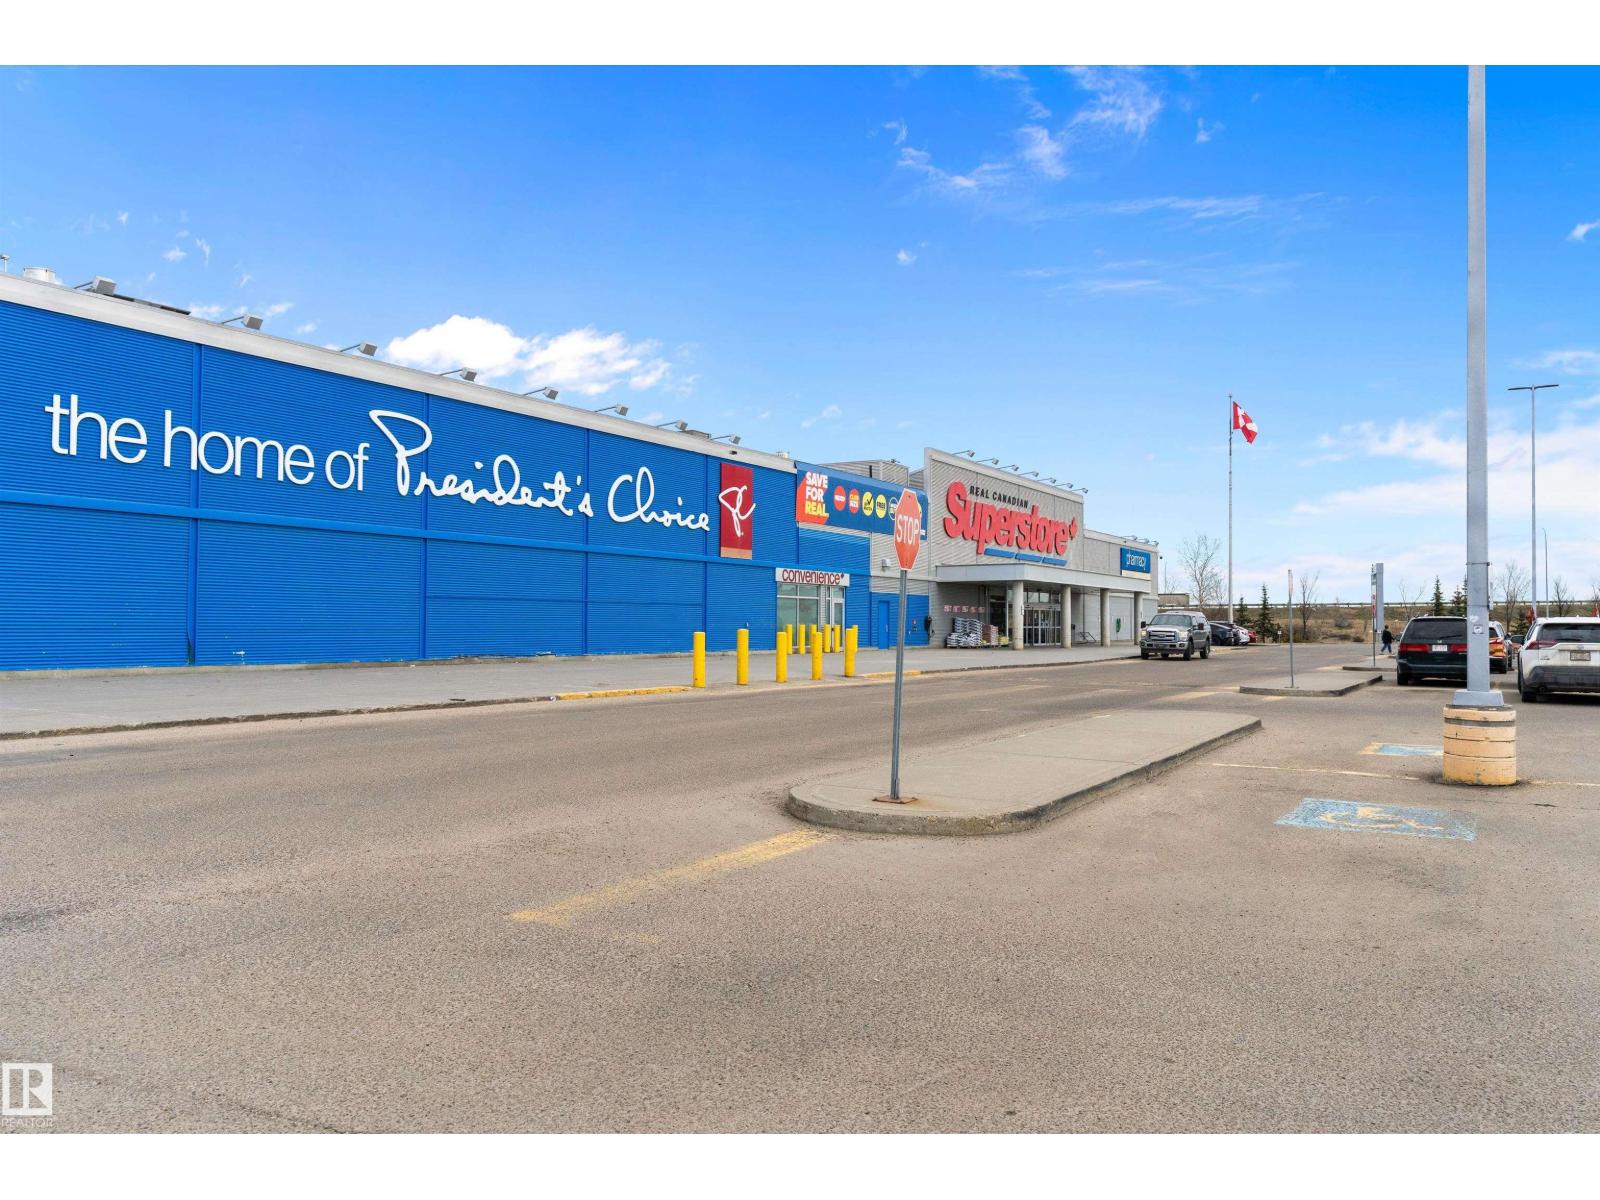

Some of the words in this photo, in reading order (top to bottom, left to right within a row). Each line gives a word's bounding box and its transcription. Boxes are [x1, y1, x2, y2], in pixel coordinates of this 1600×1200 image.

[45, 394, 147, 464] the
[164, 410, 315, 485] home
[325, 443, 369, 491] of
[369, 409, 594, 517] President's
[607, 467, 710, 531] Choice
[805, 471, 828, 489] SAVE
[805, 486, 824, 502] FOR
[970, 485, 990, 500] REAL
[992, 491, 1029, 509] CANADIAN
[943, 481, 1069, 556] Superstore
[896, 514, 920, 546] STOP
[1126, 552, 1147, 570] pharmacy
[782, 569, 840, 585] convenience
